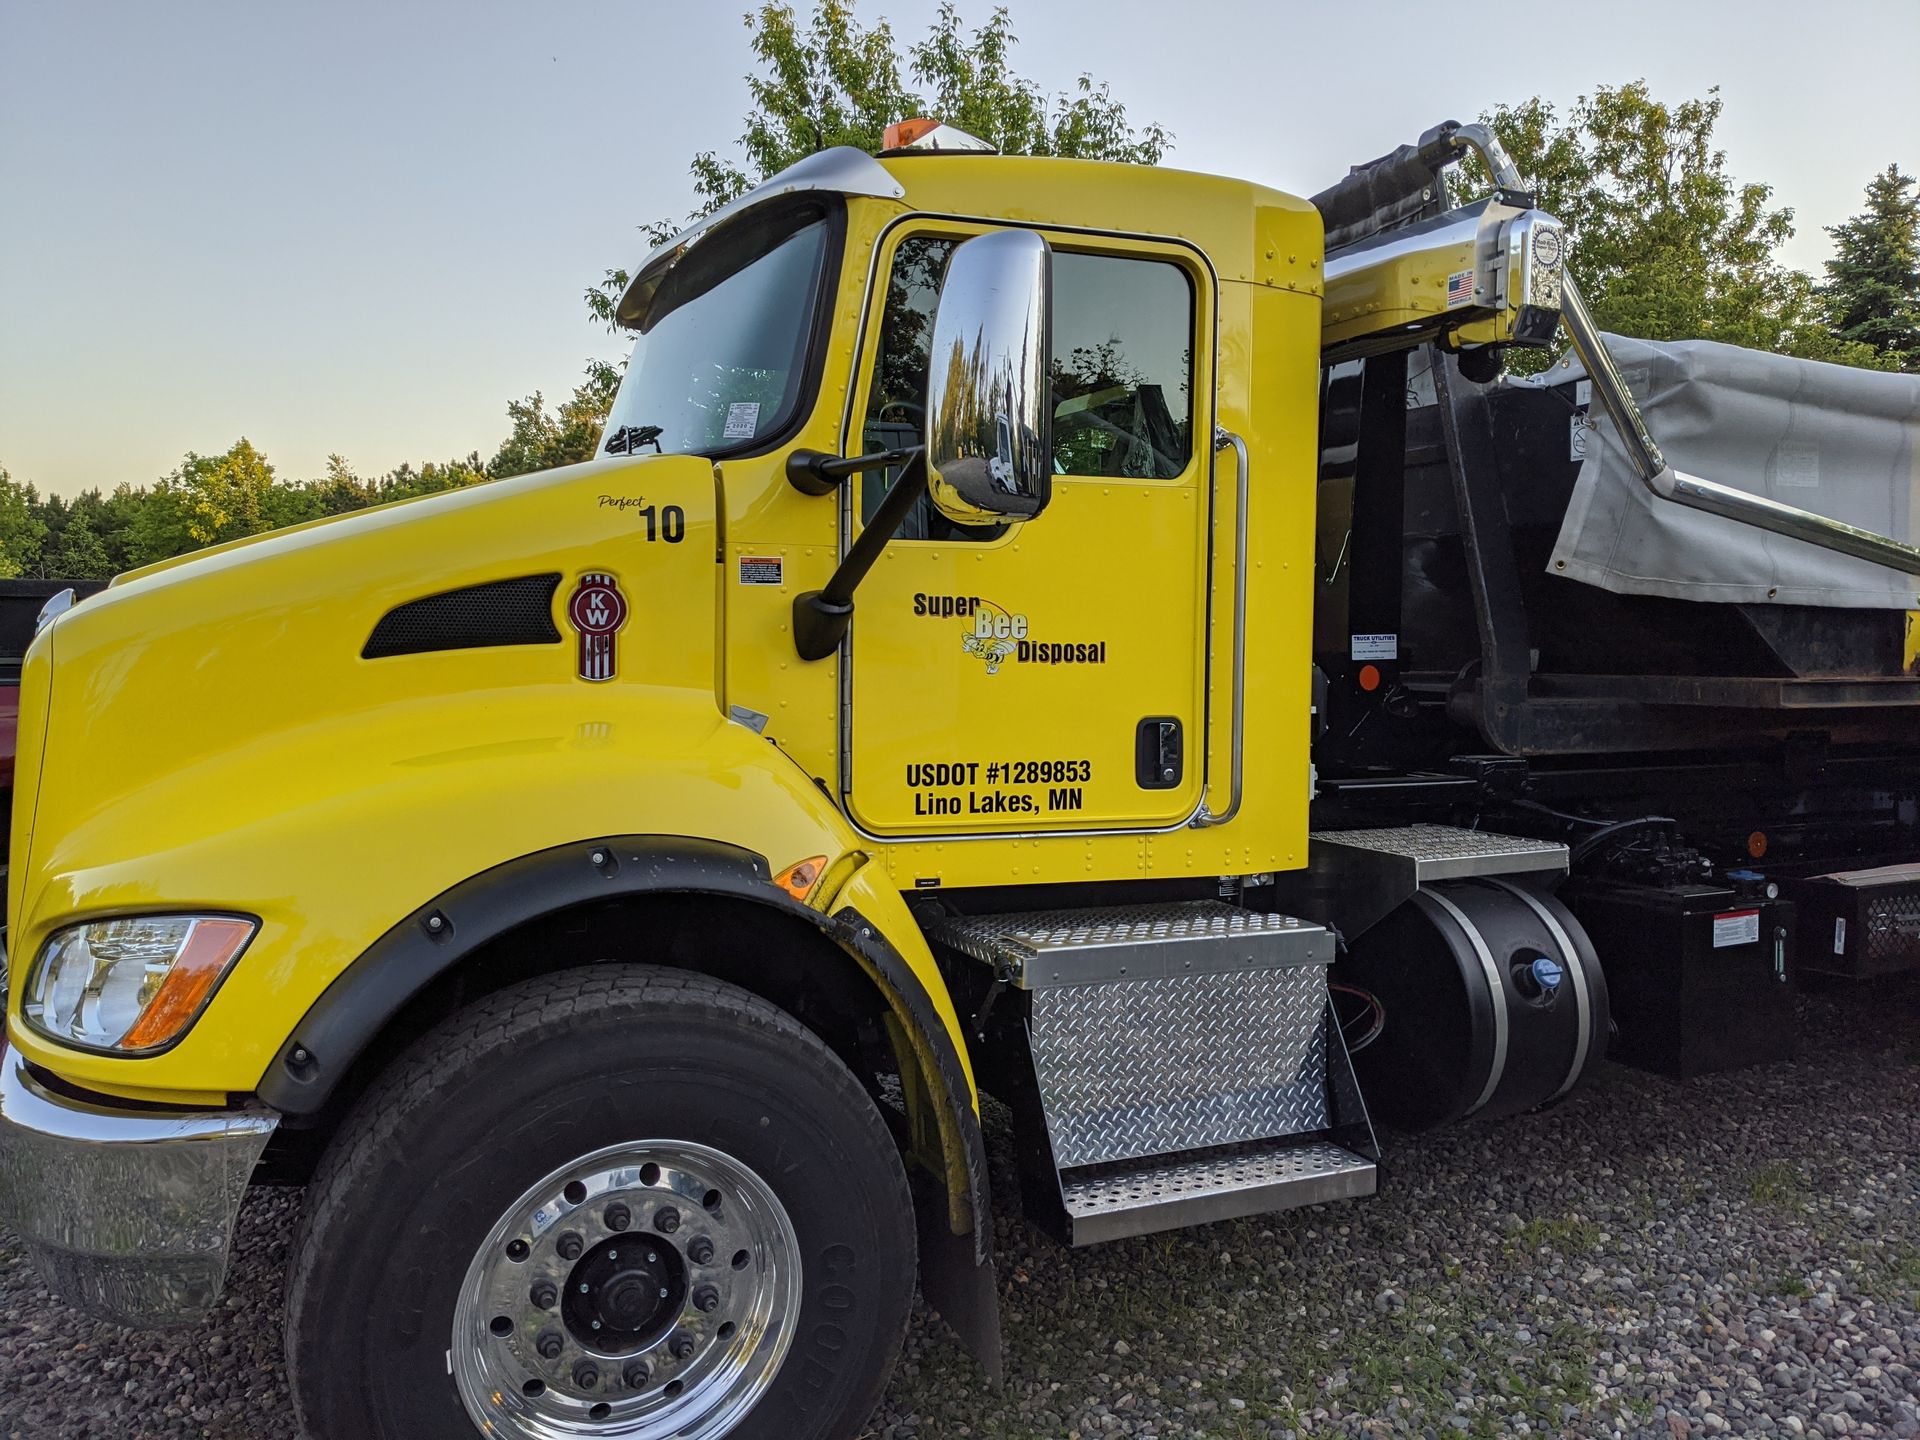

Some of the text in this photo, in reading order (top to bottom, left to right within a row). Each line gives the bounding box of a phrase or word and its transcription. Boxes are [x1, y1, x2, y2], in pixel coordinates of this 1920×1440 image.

[1448, 296, 1472, 305] AMERICA
[598, 495, 645, 511] Perfect
[638, 505, 685, 544] 10
[590, 593, 606, 609] K
[913, 592, 981, 619] Super
[585, 609, 610, 625] W
[974, 607, 1028, 640] Bee
[1017, 640, 1106, 665] Disposal
[907, 760, 1091, 787] USDOT #1289853
[915, 787, 1082, 815] Lino Lakes, MN
